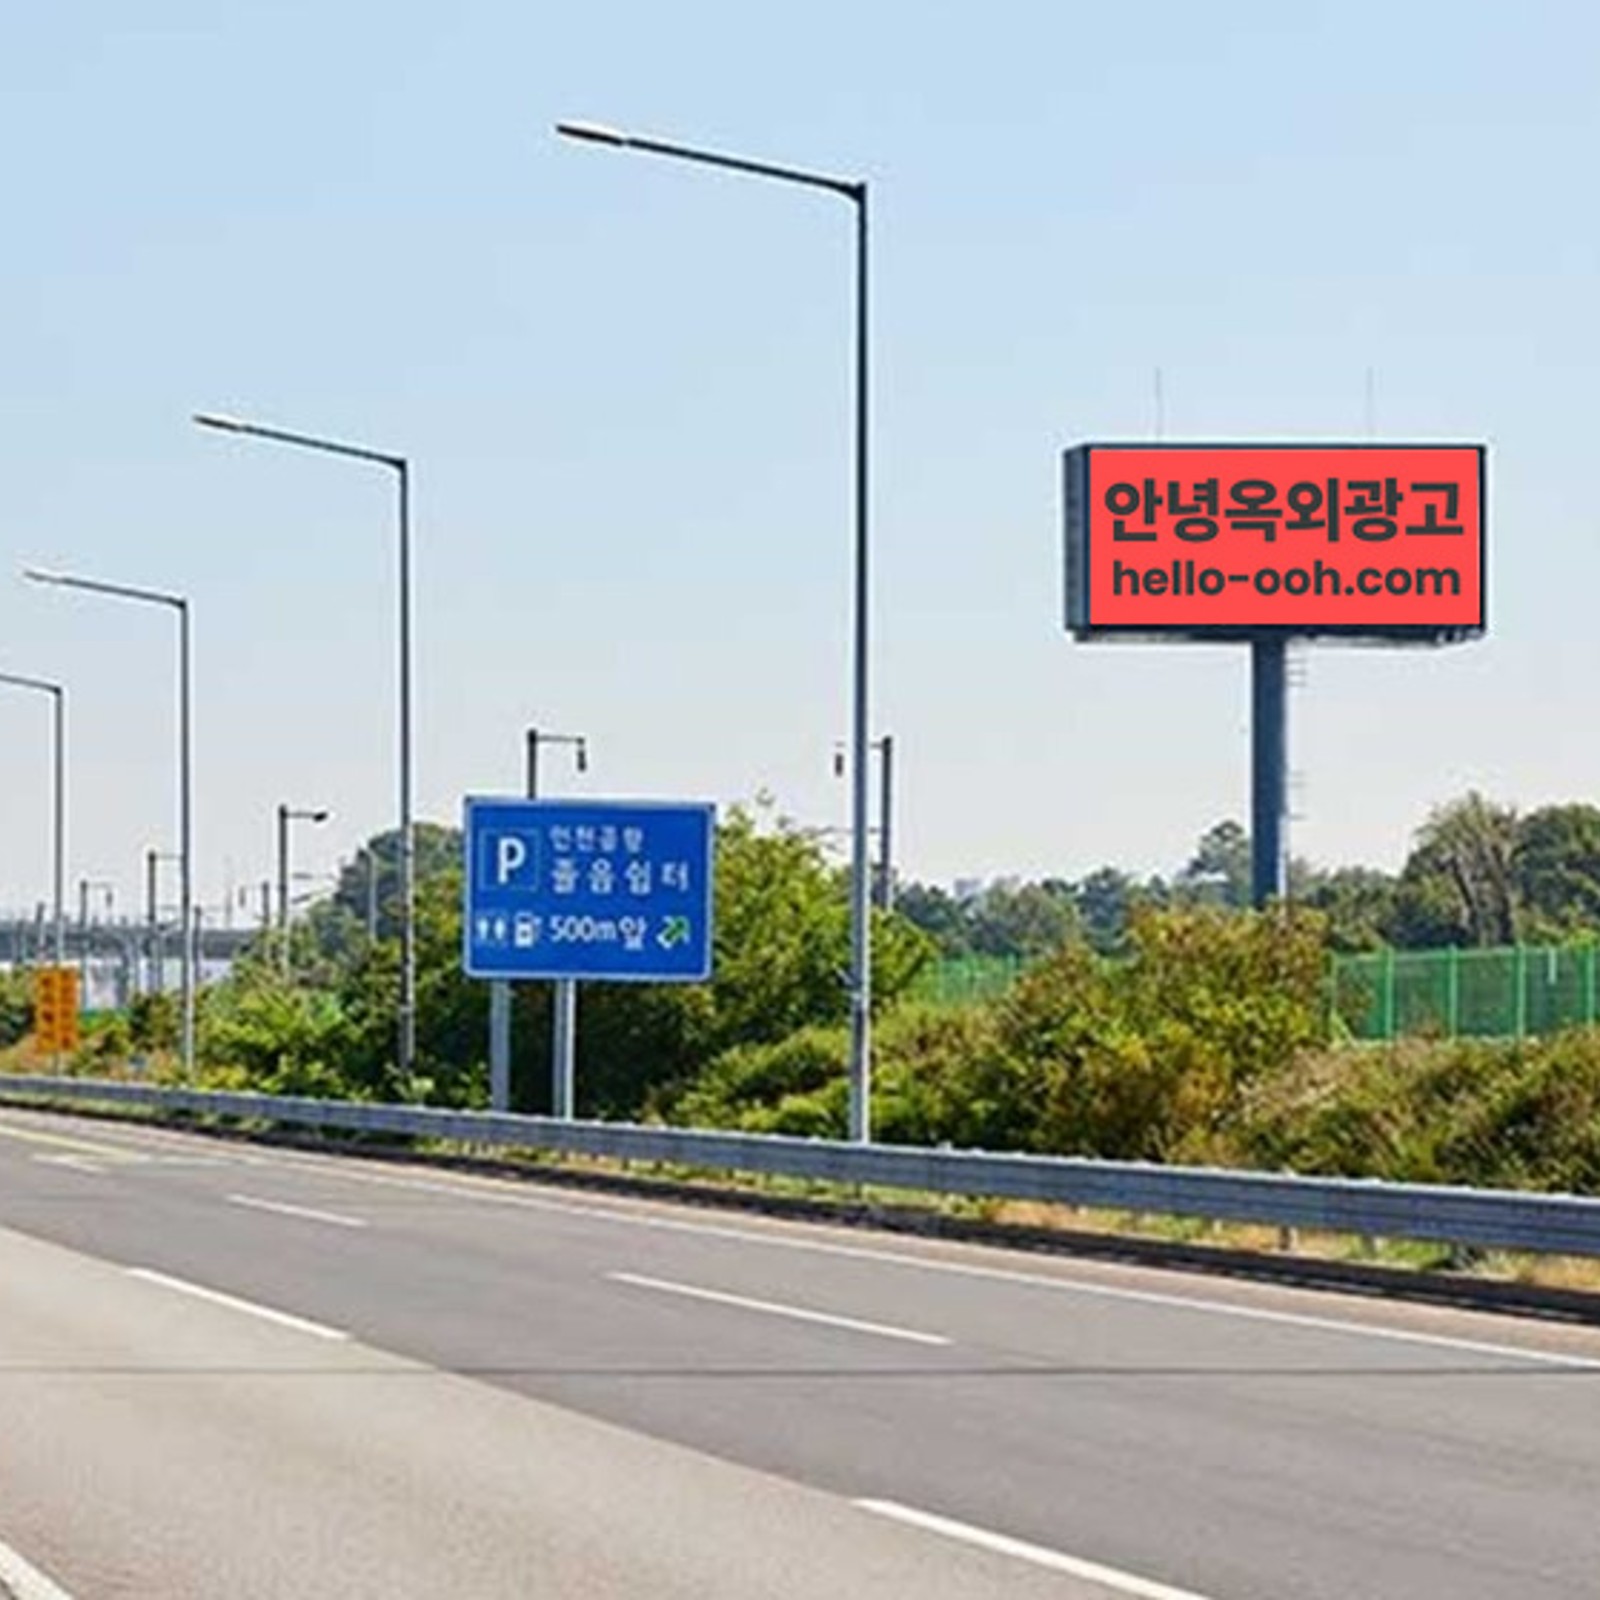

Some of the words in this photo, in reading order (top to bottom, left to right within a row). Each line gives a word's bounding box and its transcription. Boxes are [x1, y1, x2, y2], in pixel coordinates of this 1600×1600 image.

[1104, 477, 1465, 543] 안녕옥외광고
[1112, 559, 1461, 596] hello-ooh.com
[497, 836, 526, 884] P
